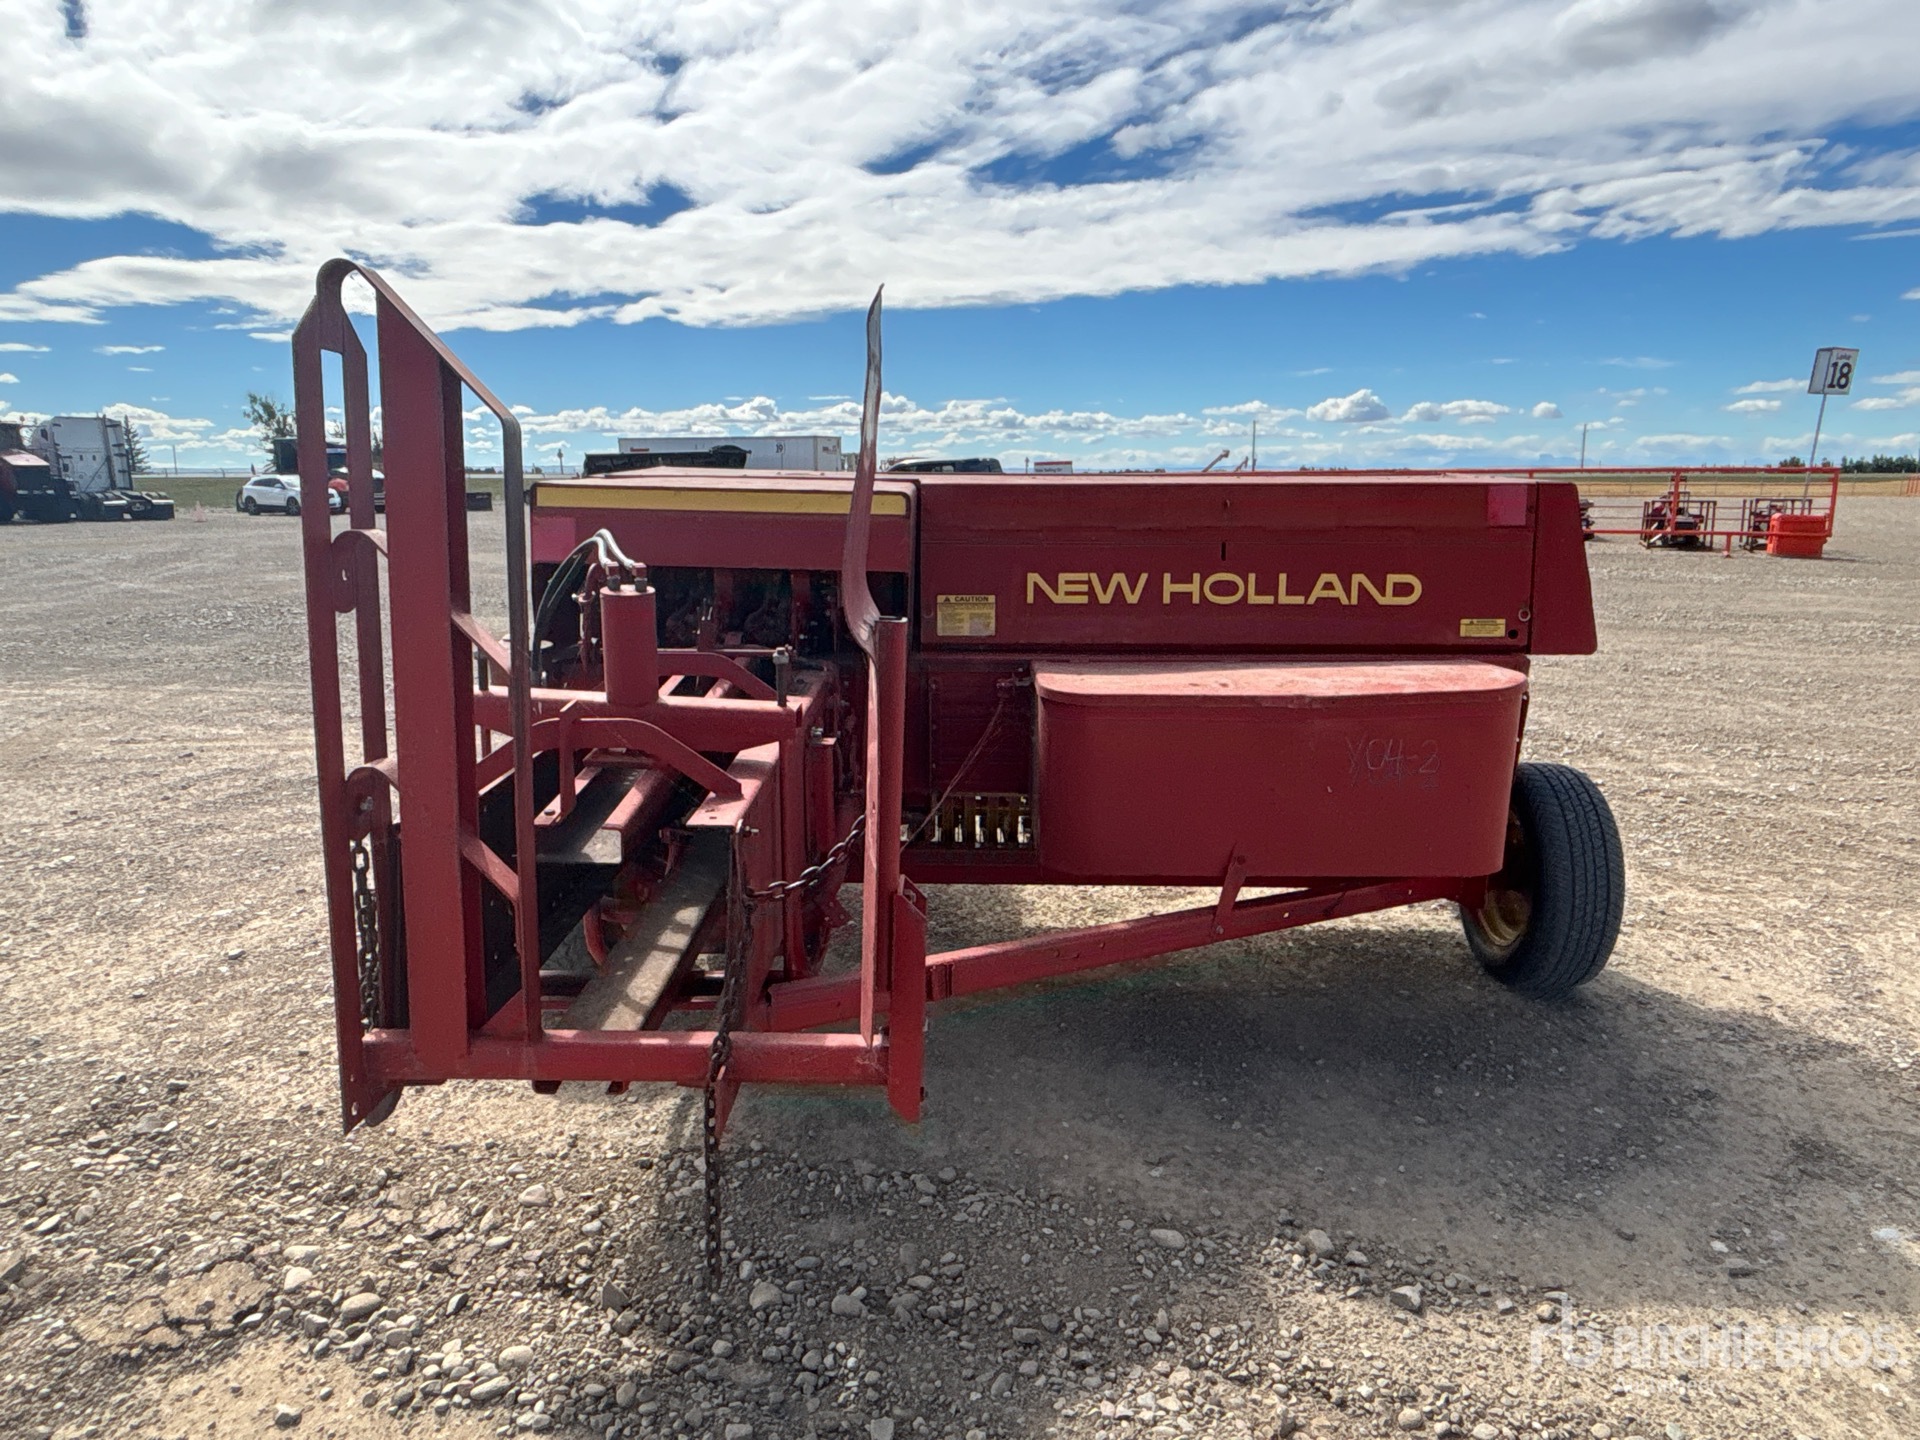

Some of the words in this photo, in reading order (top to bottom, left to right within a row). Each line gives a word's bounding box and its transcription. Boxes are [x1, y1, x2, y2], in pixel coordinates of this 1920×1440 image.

[1827, 361, 1852, 389] 18
[1026, 572, 1148, 604] NEW
[1162, 572, 1423, 606] HOLLAND
